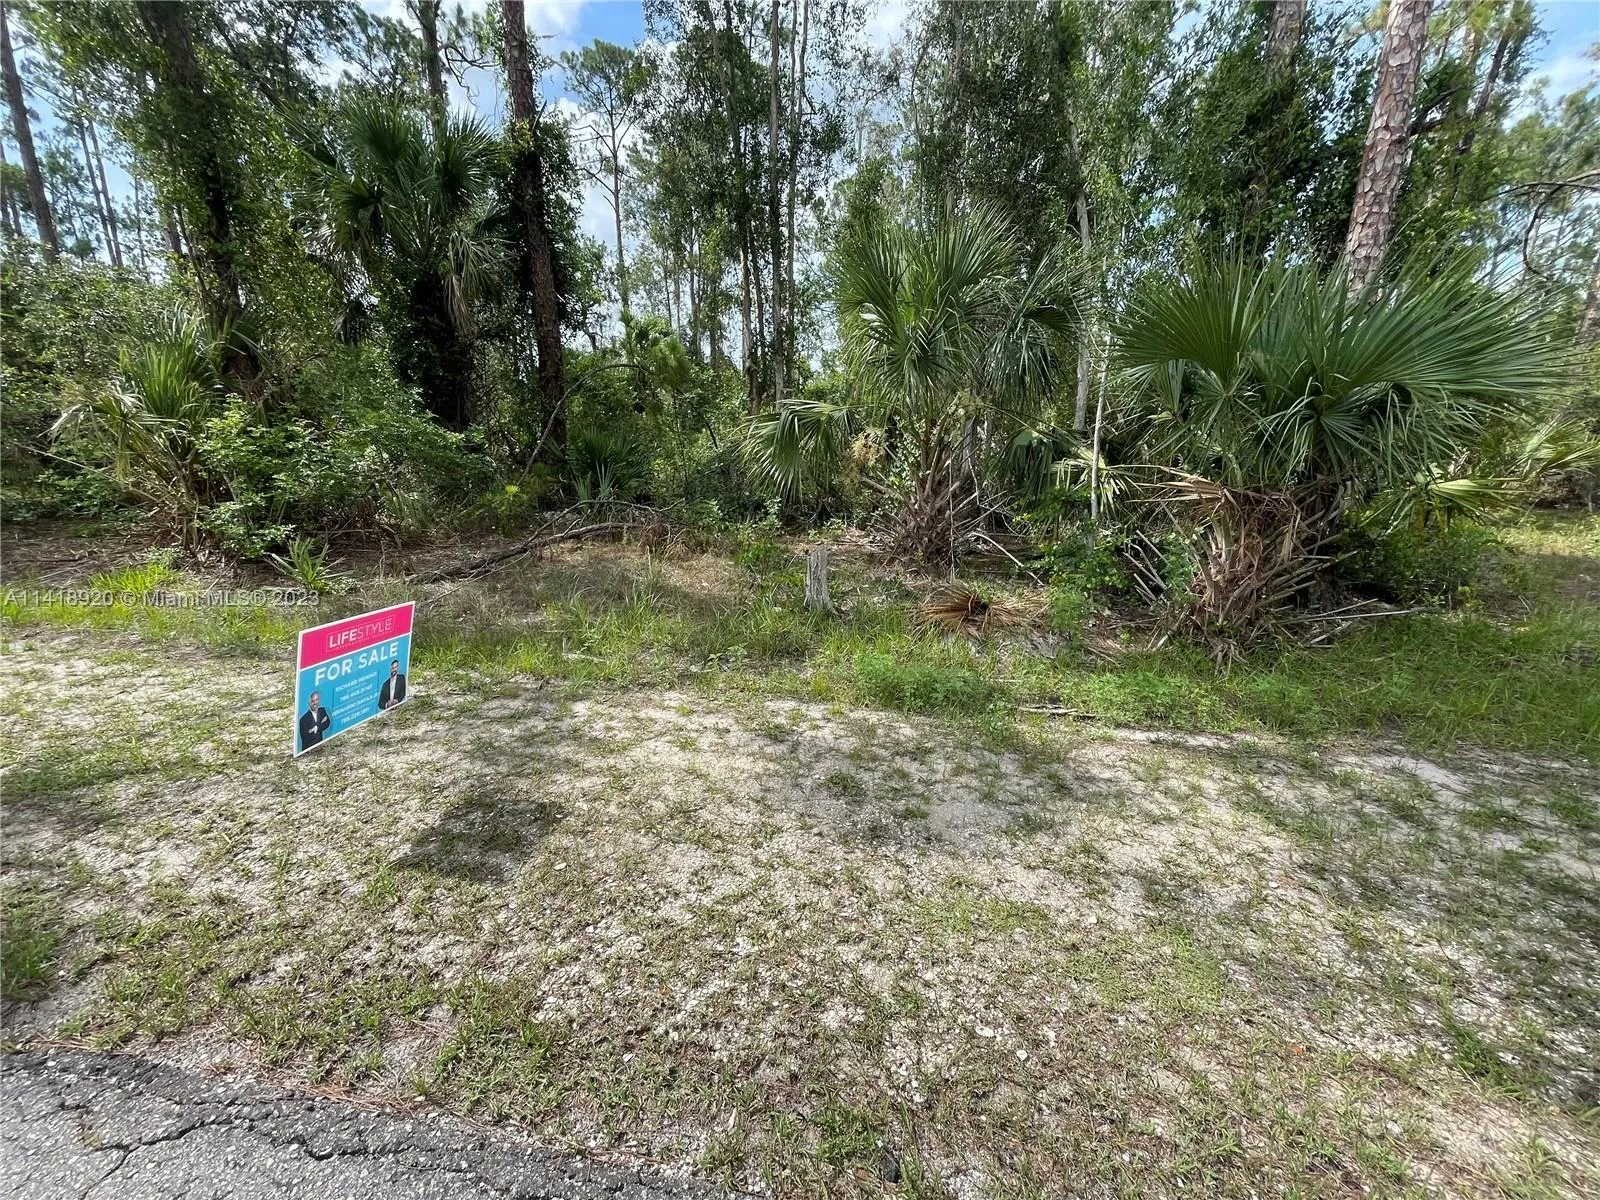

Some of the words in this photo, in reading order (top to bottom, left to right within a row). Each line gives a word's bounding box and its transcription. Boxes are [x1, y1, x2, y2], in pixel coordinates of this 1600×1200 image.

[329, 618, 392, 648] LIFESTYLE
[315, 659, 353, 686] FOR
[358, 641, 399, 669] SALE
